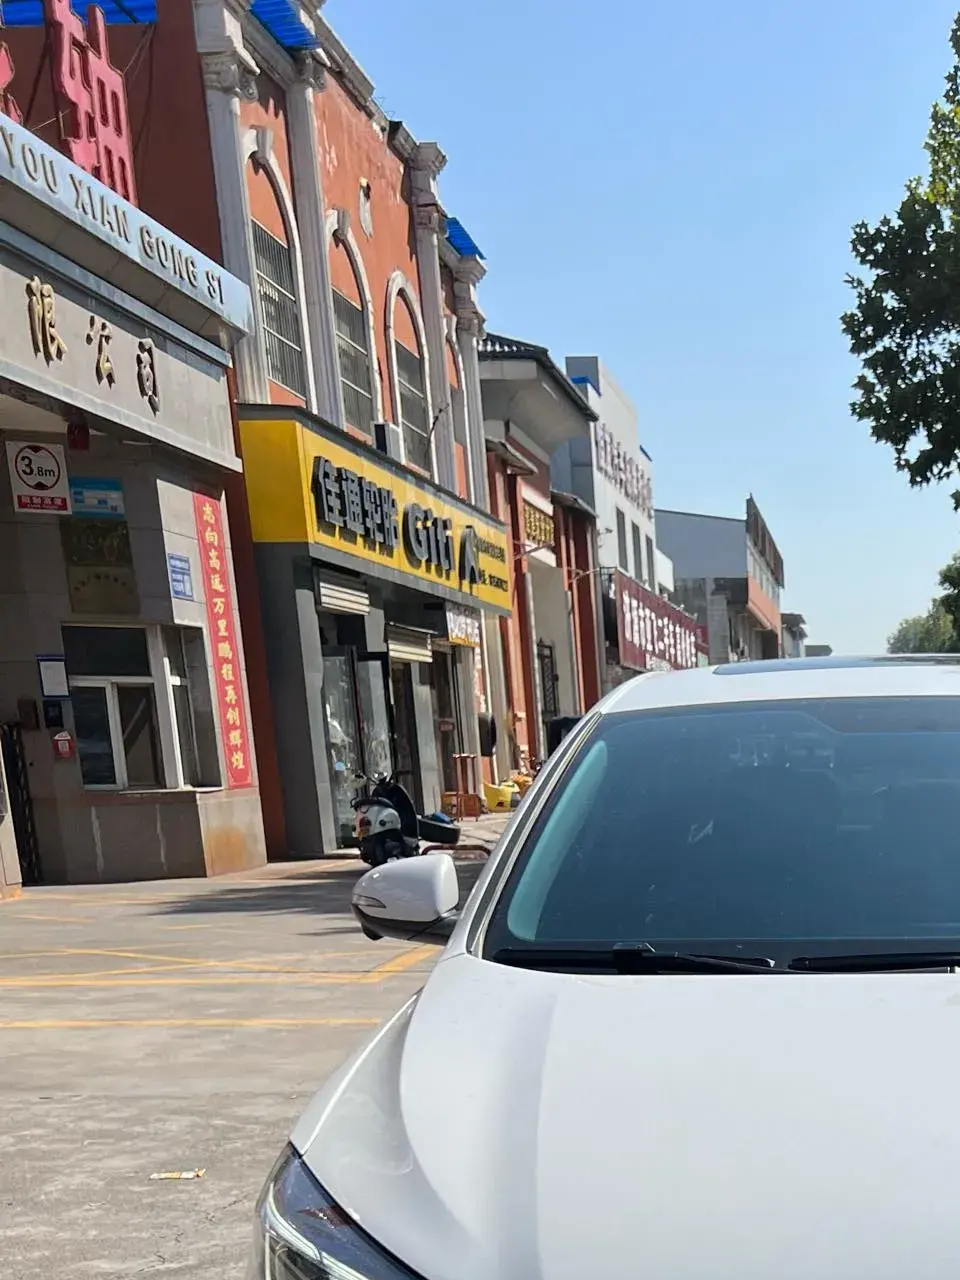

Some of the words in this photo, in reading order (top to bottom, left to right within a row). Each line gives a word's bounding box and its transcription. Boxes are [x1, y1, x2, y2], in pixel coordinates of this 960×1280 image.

[1, 125, 58, 196] YOU
[73, 173, 132, 243] XIAN
[140, 224, 199, 289] GONG
[206, 269, 225, 305] SI
[20, 455, 56, 478] 3.8m
[311, 456, 399, 551] 佳通轮胎
[403, 502, 455, 572] Giti
